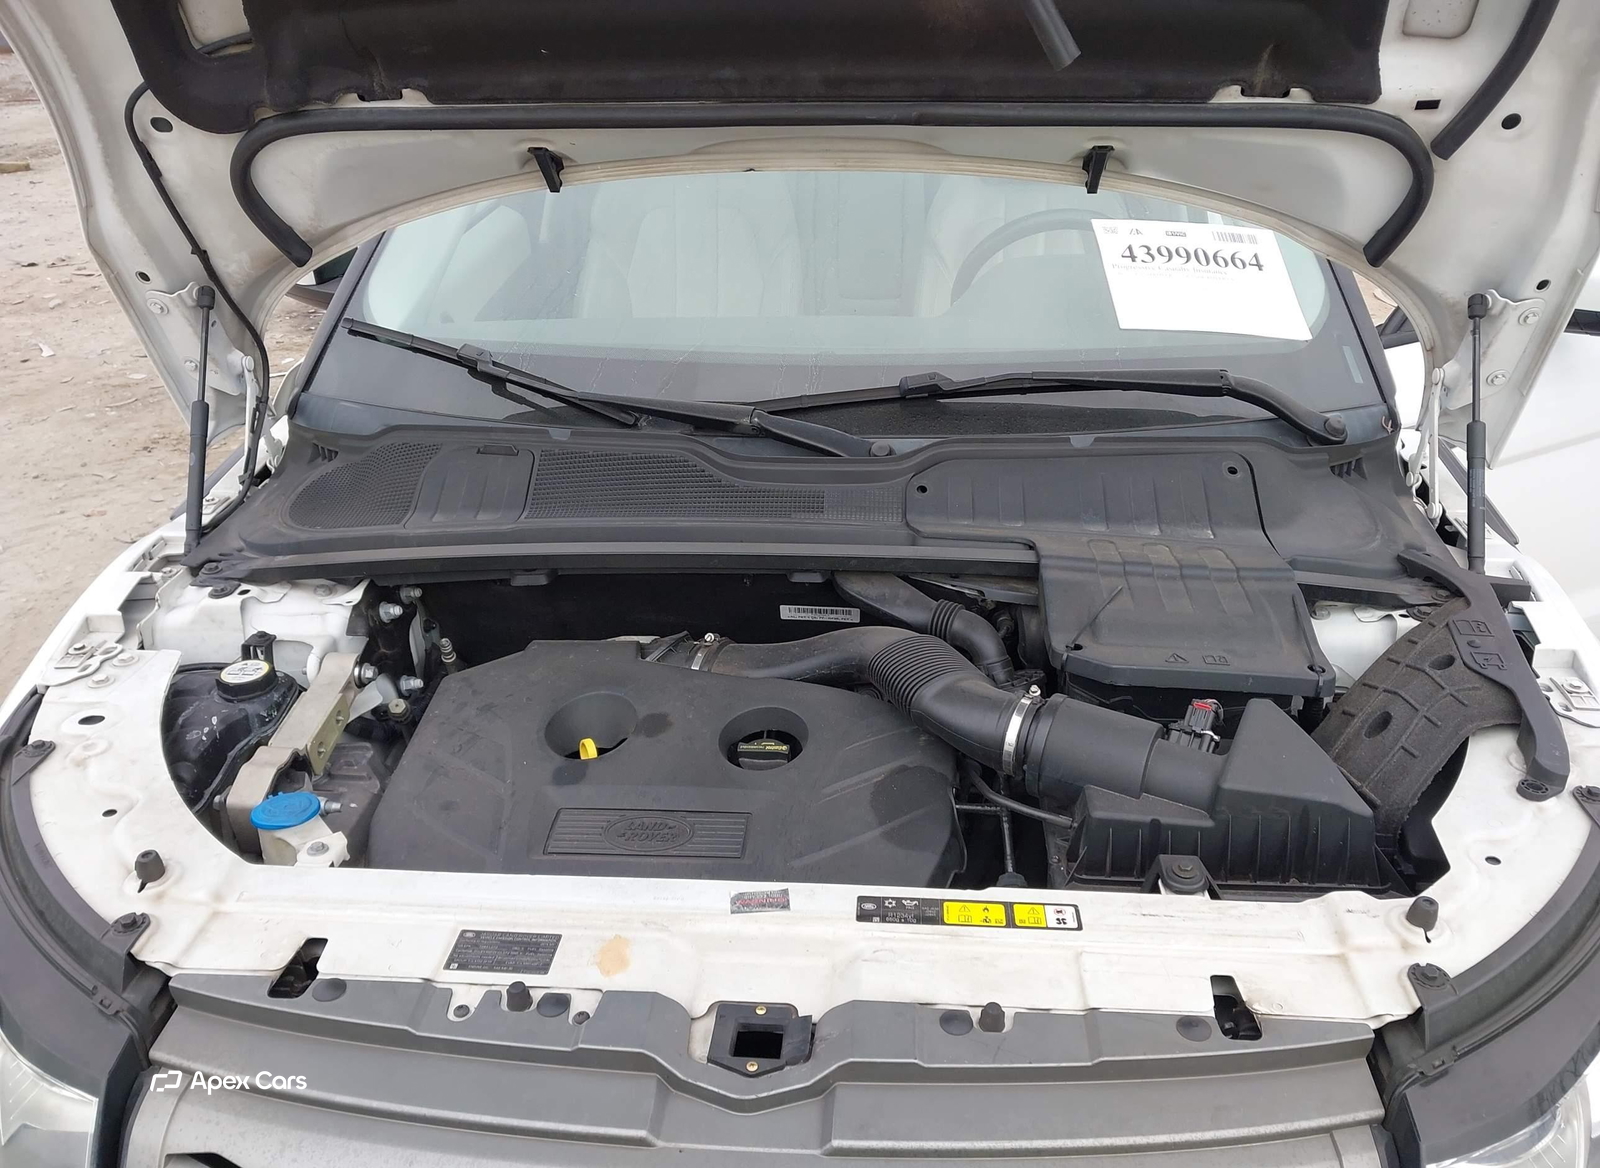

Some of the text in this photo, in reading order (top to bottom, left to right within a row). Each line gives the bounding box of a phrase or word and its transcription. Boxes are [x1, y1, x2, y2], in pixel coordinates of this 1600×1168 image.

[1120, 243, 1265, 272] 43990664
[625, 821, 667, 831] LAND
[624, 832, 679, 842] ROVER
